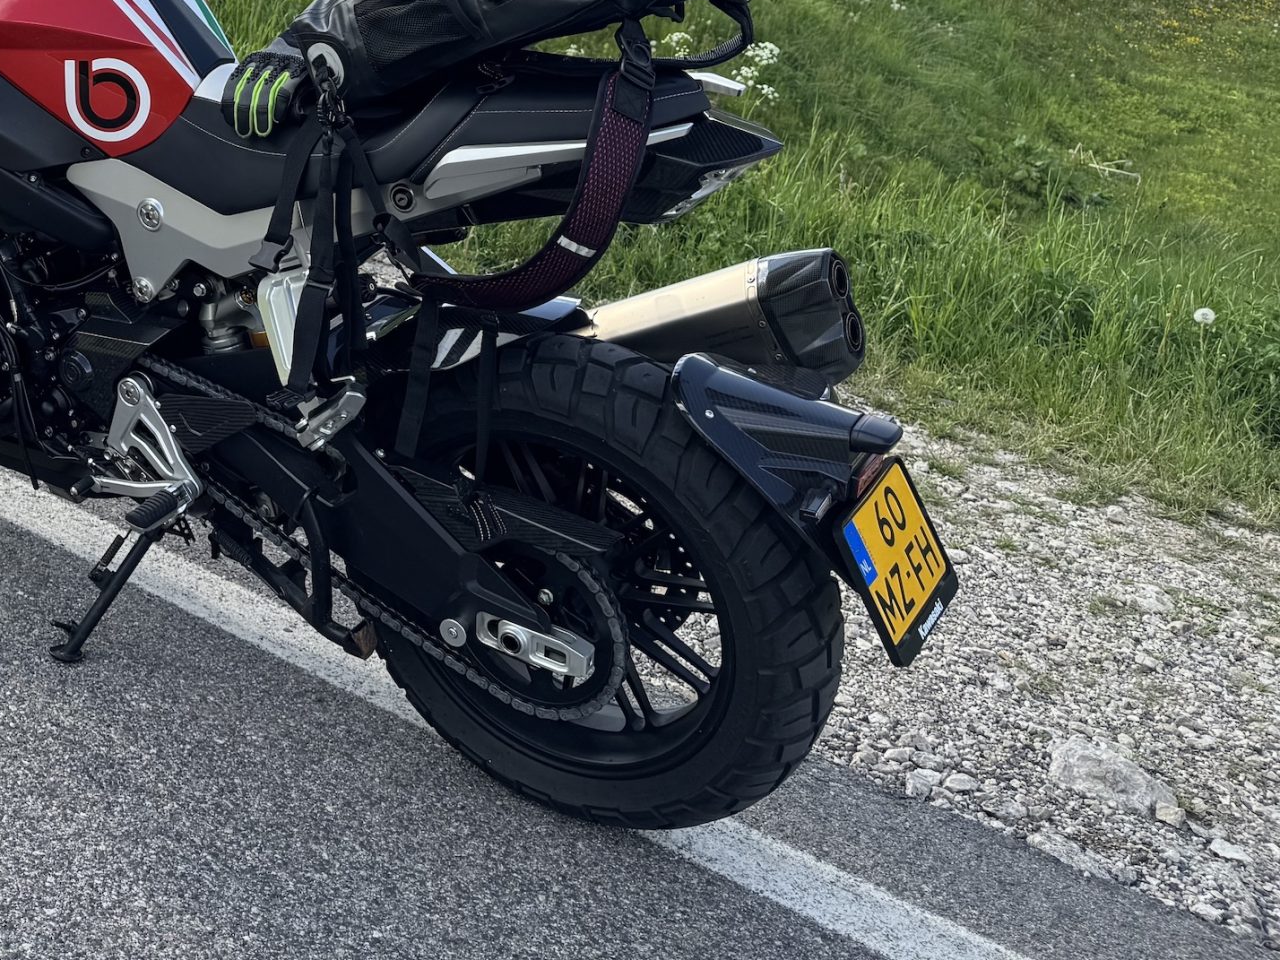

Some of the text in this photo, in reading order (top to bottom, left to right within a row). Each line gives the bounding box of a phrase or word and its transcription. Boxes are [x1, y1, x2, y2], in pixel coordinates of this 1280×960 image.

[874, 486, 906, 547] 60
[860, 559, 872, 577] NL
[875, 526, 940, 635] MZ-FH
[918, 598, 944, 640] Kawasaki
